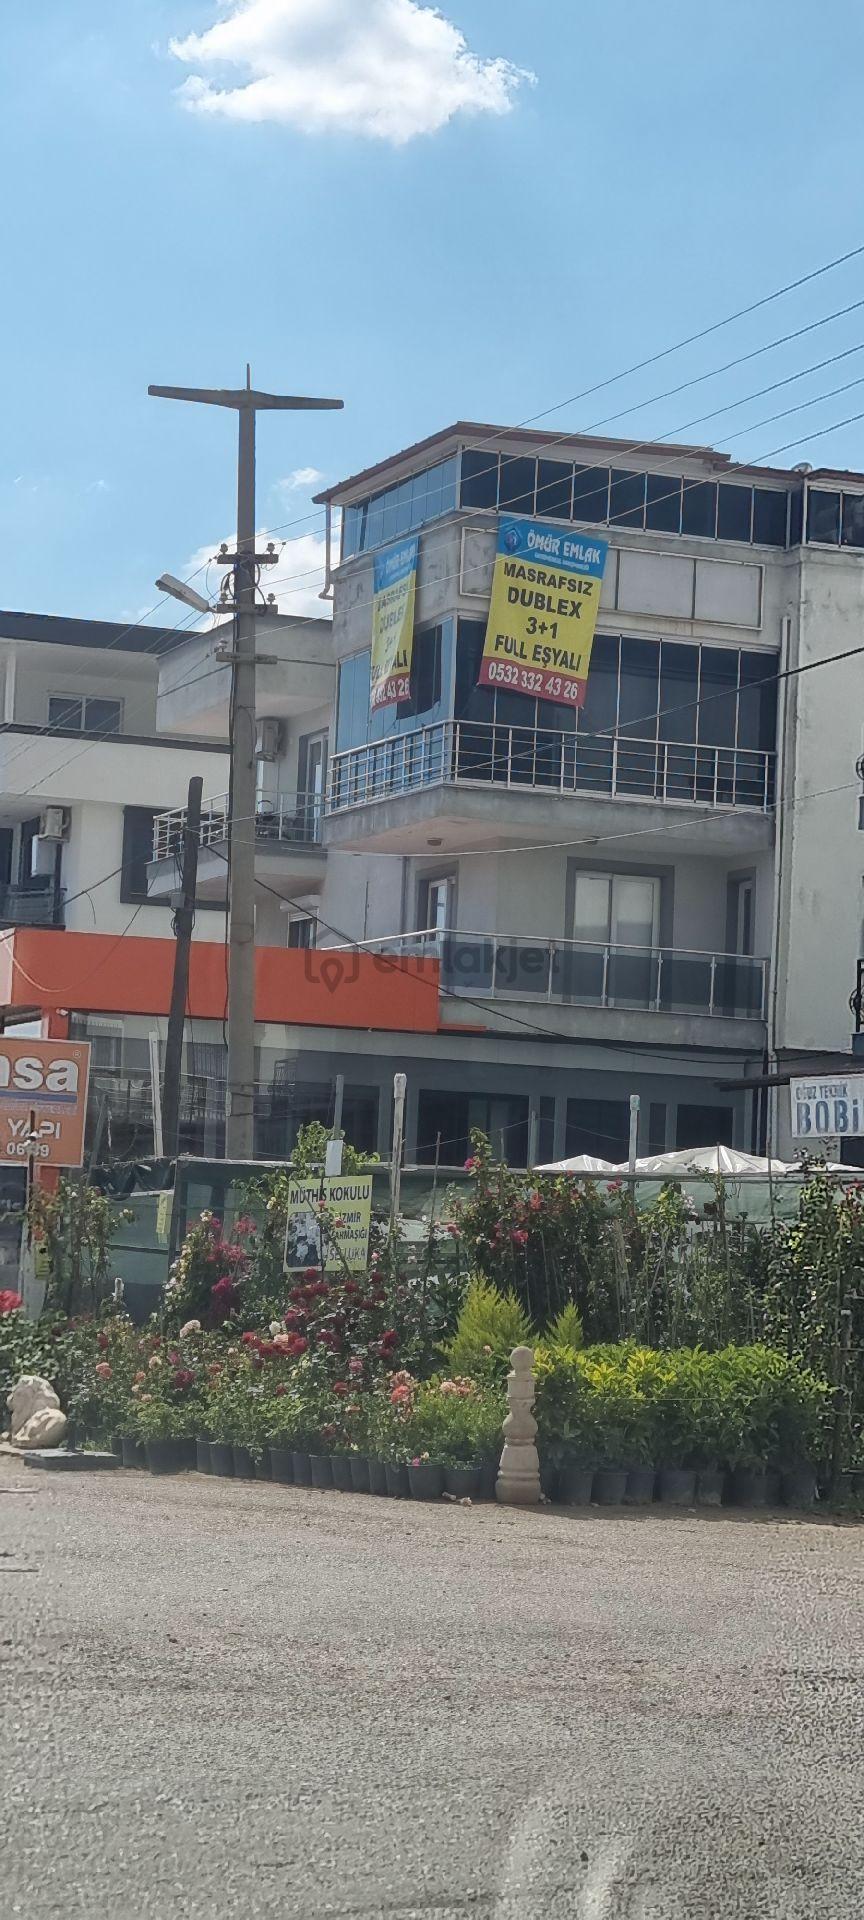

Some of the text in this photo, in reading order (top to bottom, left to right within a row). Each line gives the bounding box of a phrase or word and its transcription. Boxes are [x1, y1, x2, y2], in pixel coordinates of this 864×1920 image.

[527, 530, 560, 555] ÖMÜR
[563, 541, 601, 564] EMLAK
[503, 562, 594, 596] MASRAFSIZ
[507, 586, 583, 619] DUBLEX
[525, 616, 558, 639] 3+1
[494, 634, 582, 672] FULL EŞYALI
[398, 677, 410, 697] 26
[488, 661, 578, 700] 0532 332 43 26
[329, 1185, 370, 1202] KOKULU
